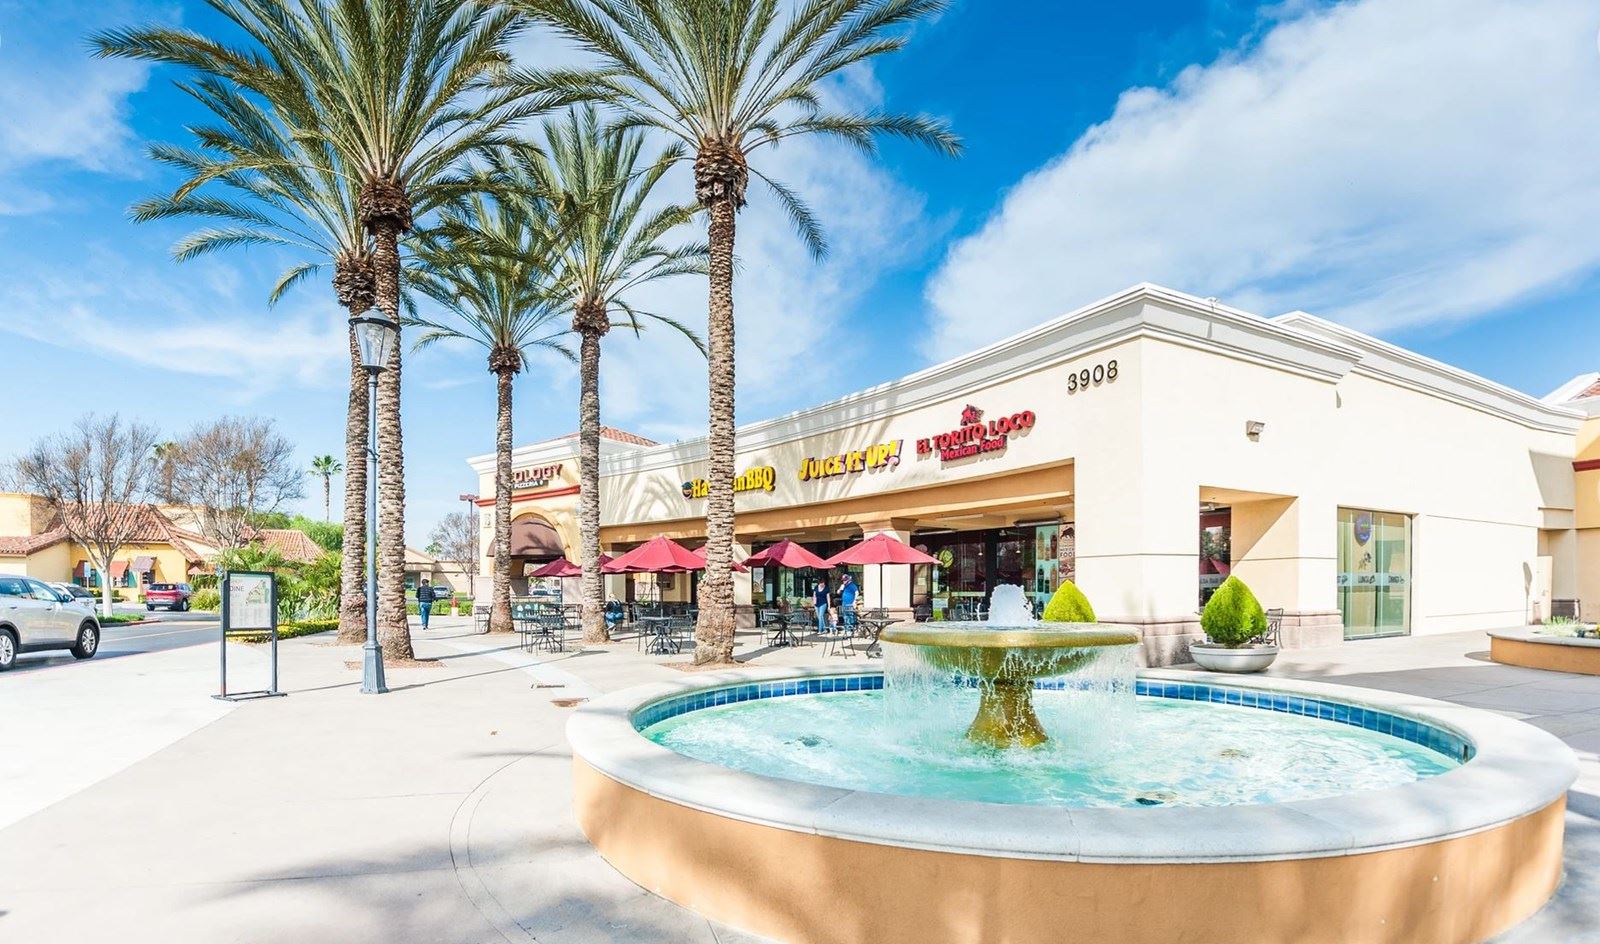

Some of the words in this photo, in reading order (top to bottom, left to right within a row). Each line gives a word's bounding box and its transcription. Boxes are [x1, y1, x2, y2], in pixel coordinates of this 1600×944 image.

[1067, 359, 1118, 391] 3908
[916, 438, 932, 454] EL
[932, 422, 987, 449] TORITO
[989, 410, 1036, 436] LOCO
[940, 442, 977, 462] Mexican
[980, 434, 1007, 453] Food
[511, 463, 563, 483] OLOGY
[798, 455, 846, 482] JUICE
[845, 450, 866, 473] IT
[866, 439, 904, 469] UP!
